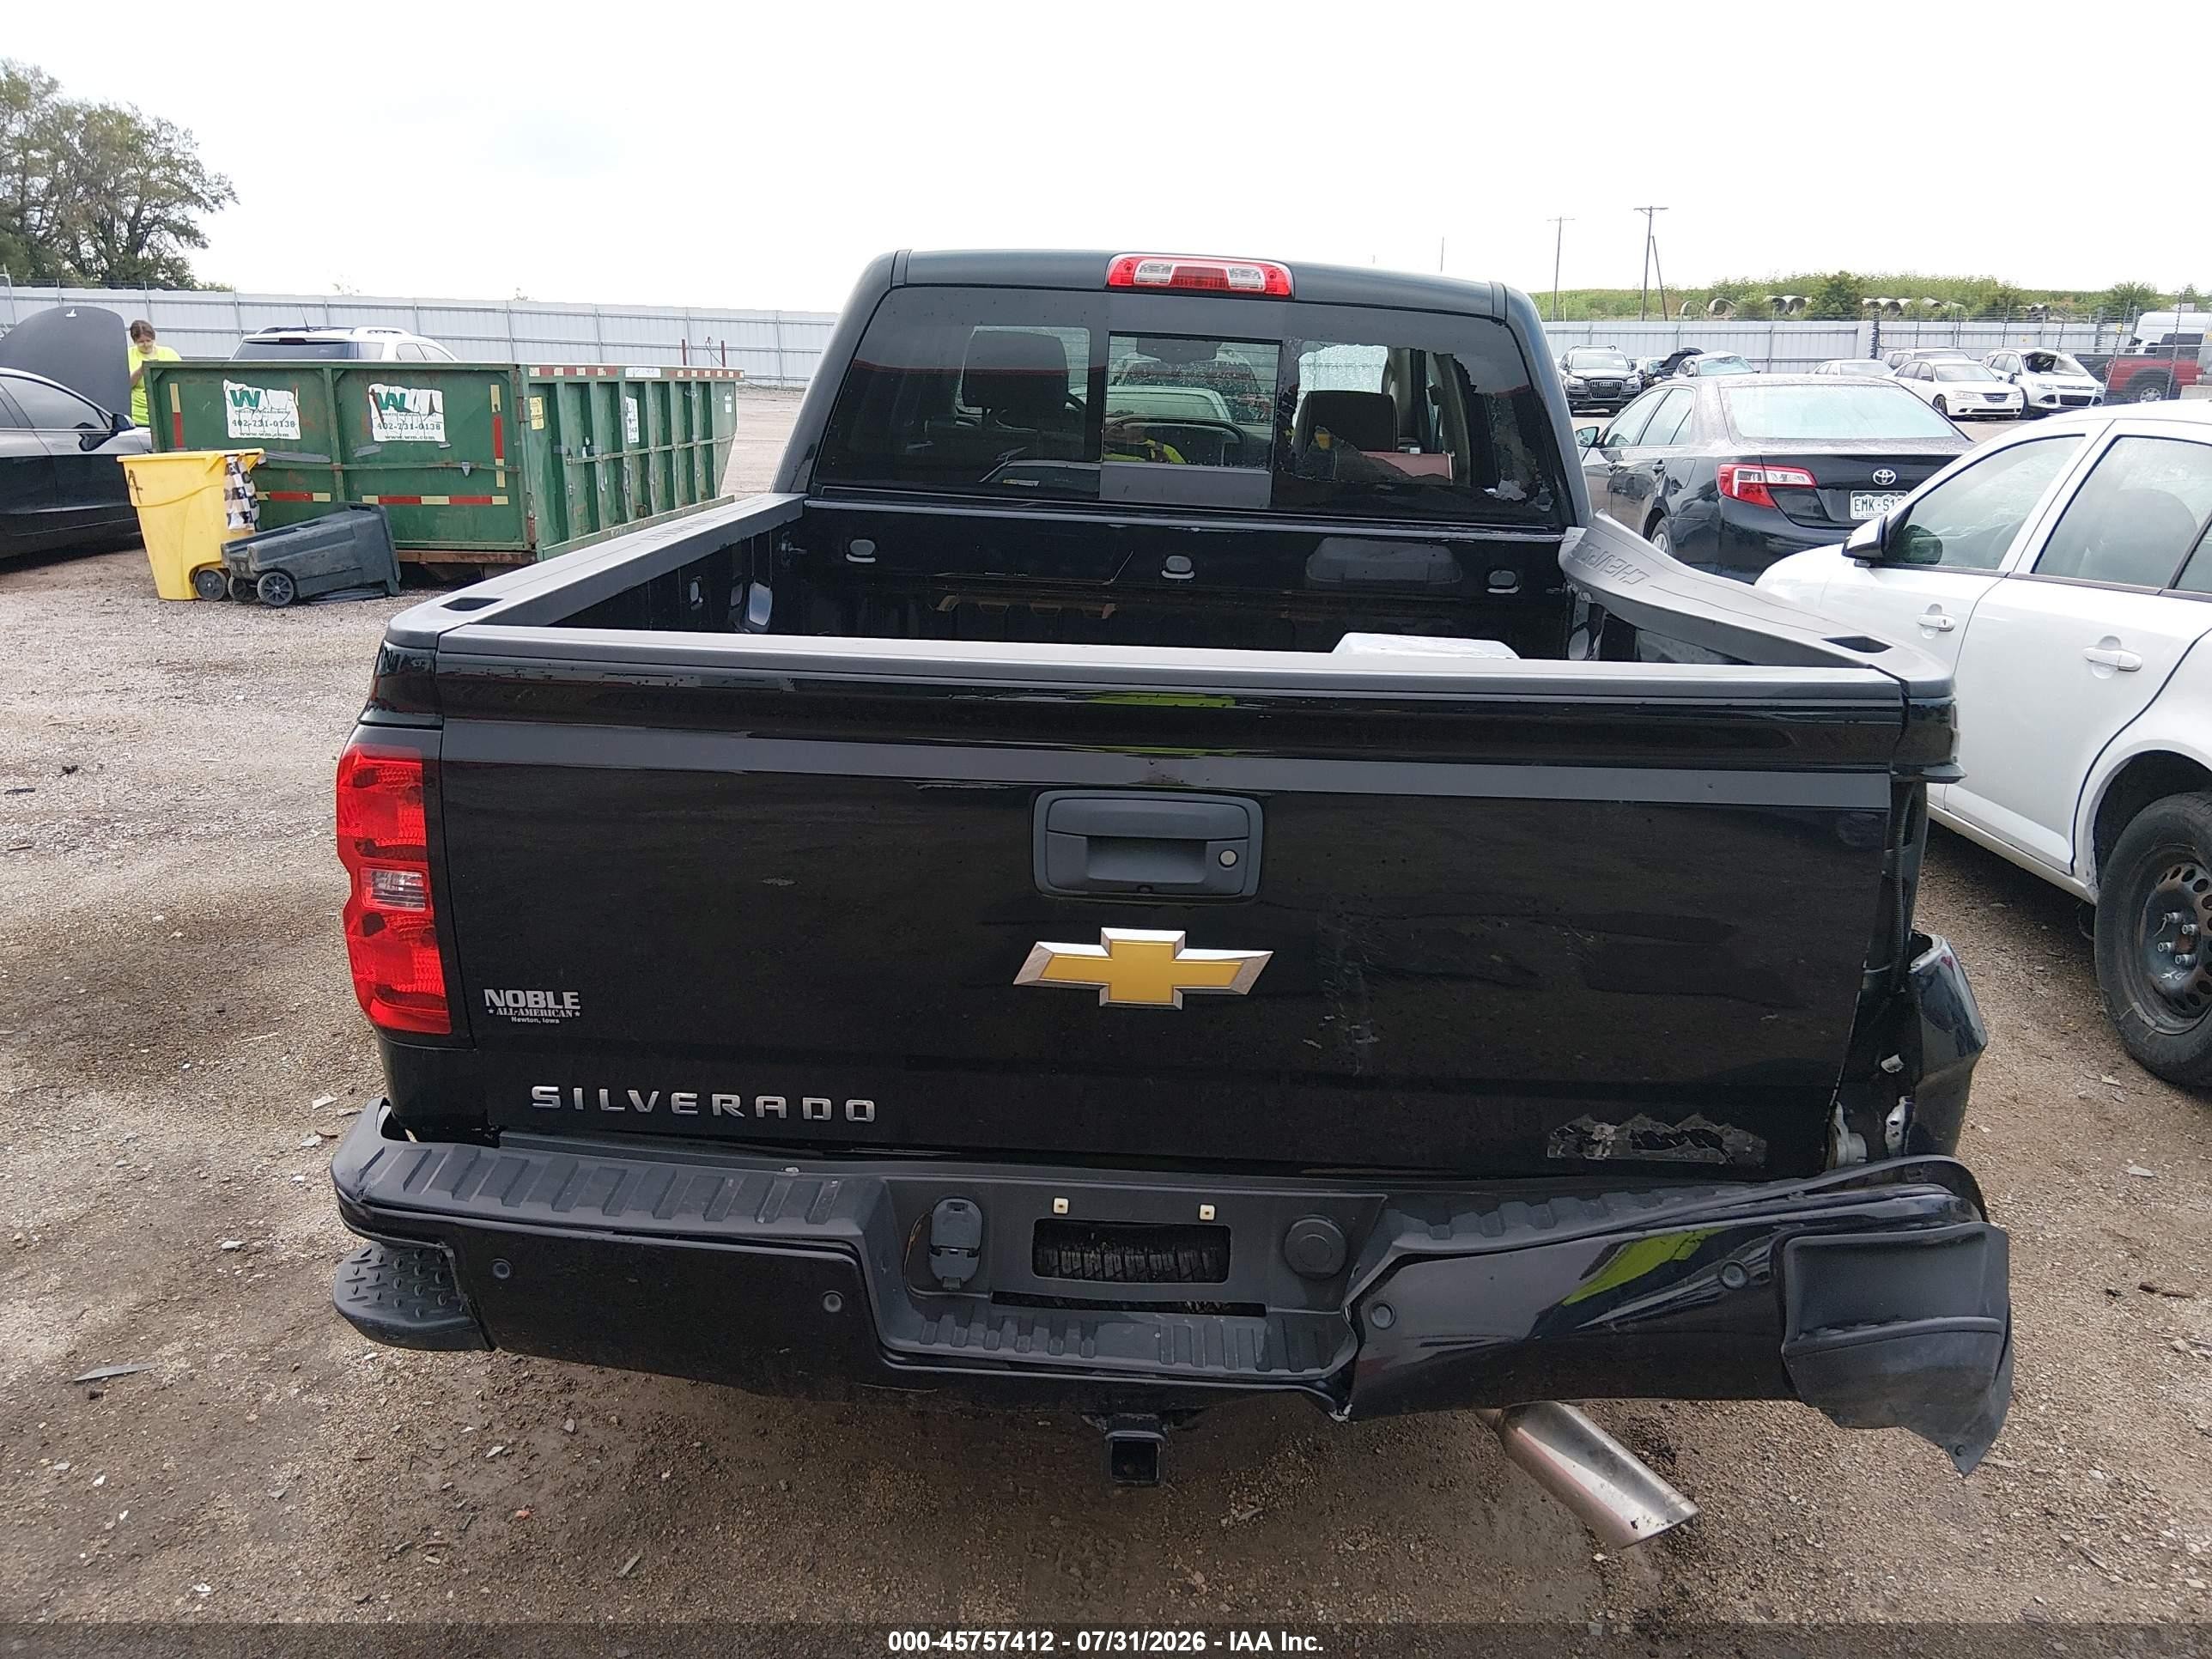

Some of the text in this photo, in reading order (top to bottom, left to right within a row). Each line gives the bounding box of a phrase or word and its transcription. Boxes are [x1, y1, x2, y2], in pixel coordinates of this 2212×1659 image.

[483, 988, 581, 1010] NOBLE
[495, 1007, 574, 1018] ALL-AMERICAN
[531, 1085, 876, 1123] SILVERADO
